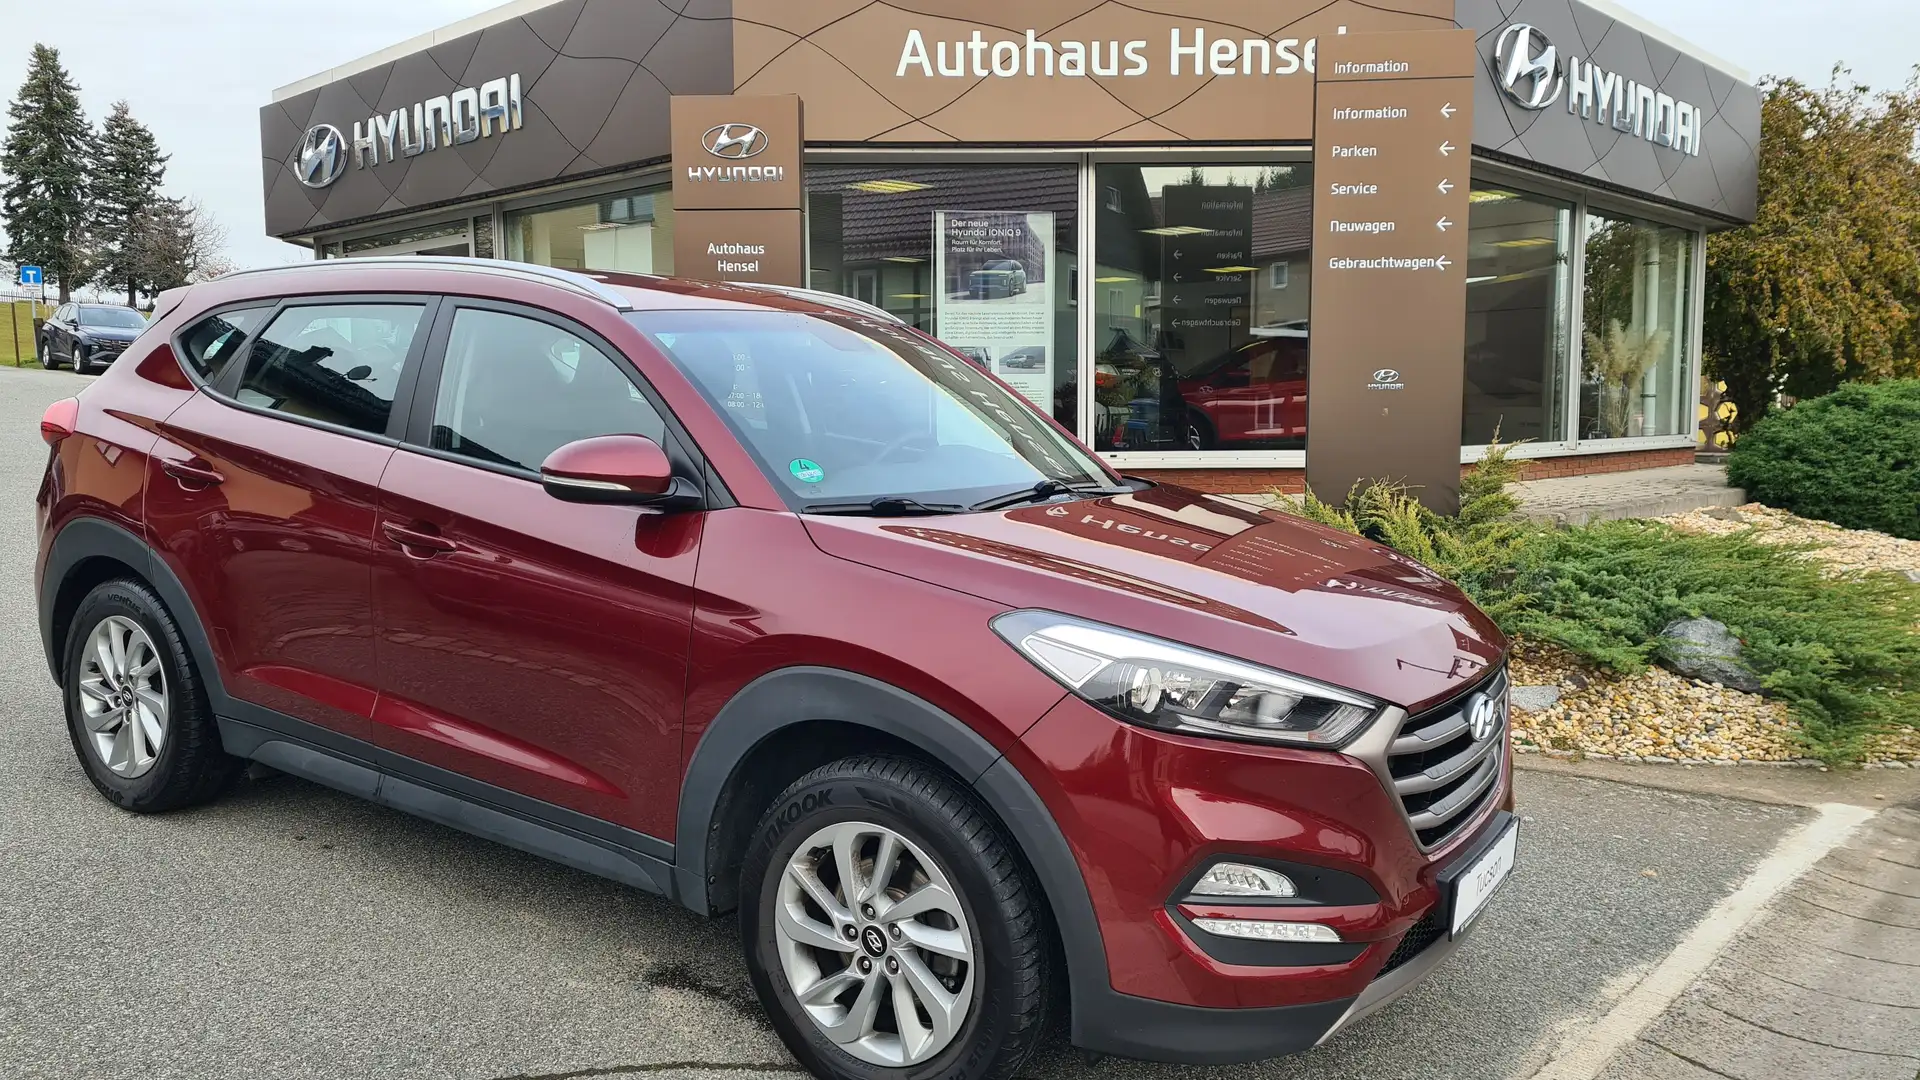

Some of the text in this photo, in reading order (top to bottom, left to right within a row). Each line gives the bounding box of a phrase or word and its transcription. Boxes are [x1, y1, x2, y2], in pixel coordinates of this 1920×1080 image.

[896, 26, 1347, 77] Autohaus Hens
[1334, 60, 1409, 74] Information
[1333, 106, 1408, 120] Information
[1567, 55, 1702, 157] HYUNDAI
[353, 73, 523, 170] HYUNDAI
[1332, 145, 1377, 158] Parken
[688, 166, 783, 182] HYUNDAI
[1331, 183, 1378, 195] Service
[951, 219, 989, 228] Der neue
[1330, 220, 1395, 234] Neuwagen
[951, 228, 1022, 238] Hyundai IONIQ 9
[707, 242, 765, 255] Autohaus
[717, 260, 759, 272] Hensel
[1329, 256, 1435, 271] Gebrauchtwagen
